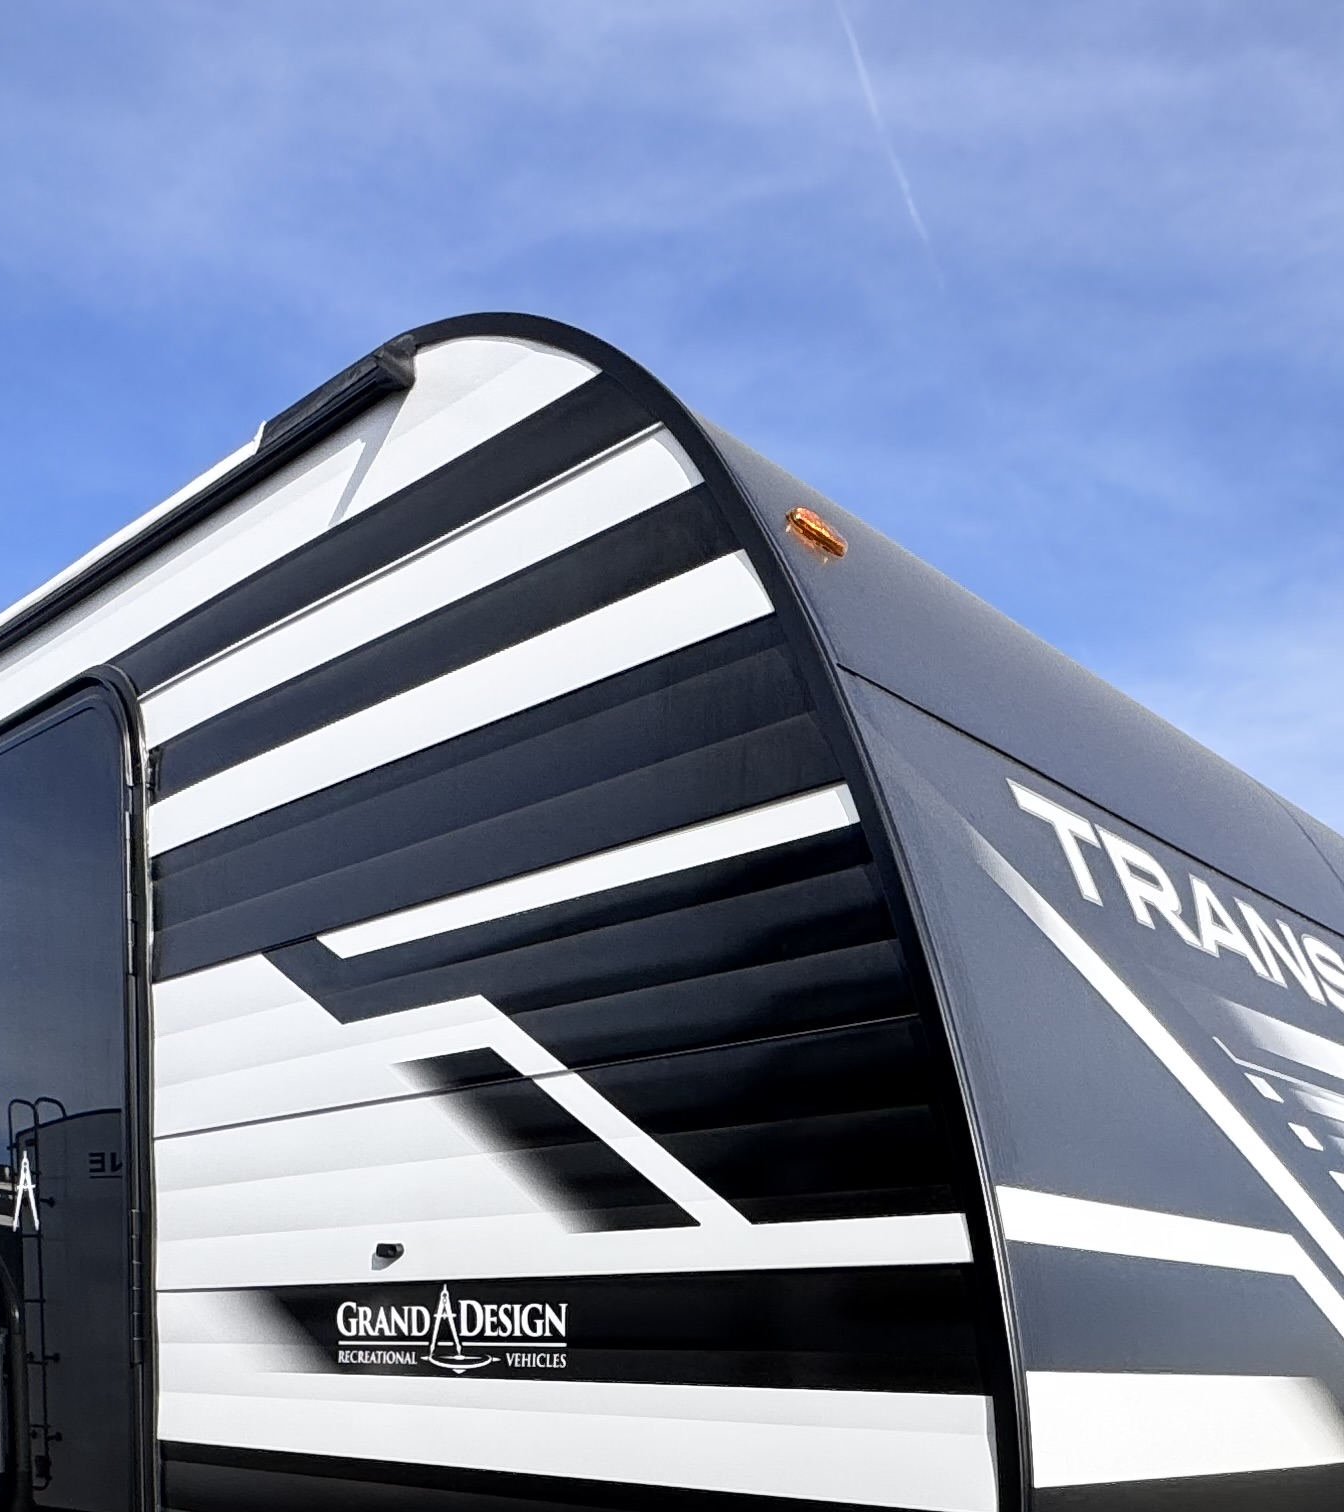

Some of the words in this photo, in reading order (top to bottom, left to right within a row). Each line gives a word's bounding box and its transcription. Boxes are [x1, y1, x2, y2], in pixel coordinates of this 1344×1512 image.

[336, 1301, 431, 1337] GRAND
[457, 1299, 568, 1338] DESIGN
[338, 1350, 418, 1365] RECREATIONAL
[506, 1352, 567, 1369] VEHICLES
